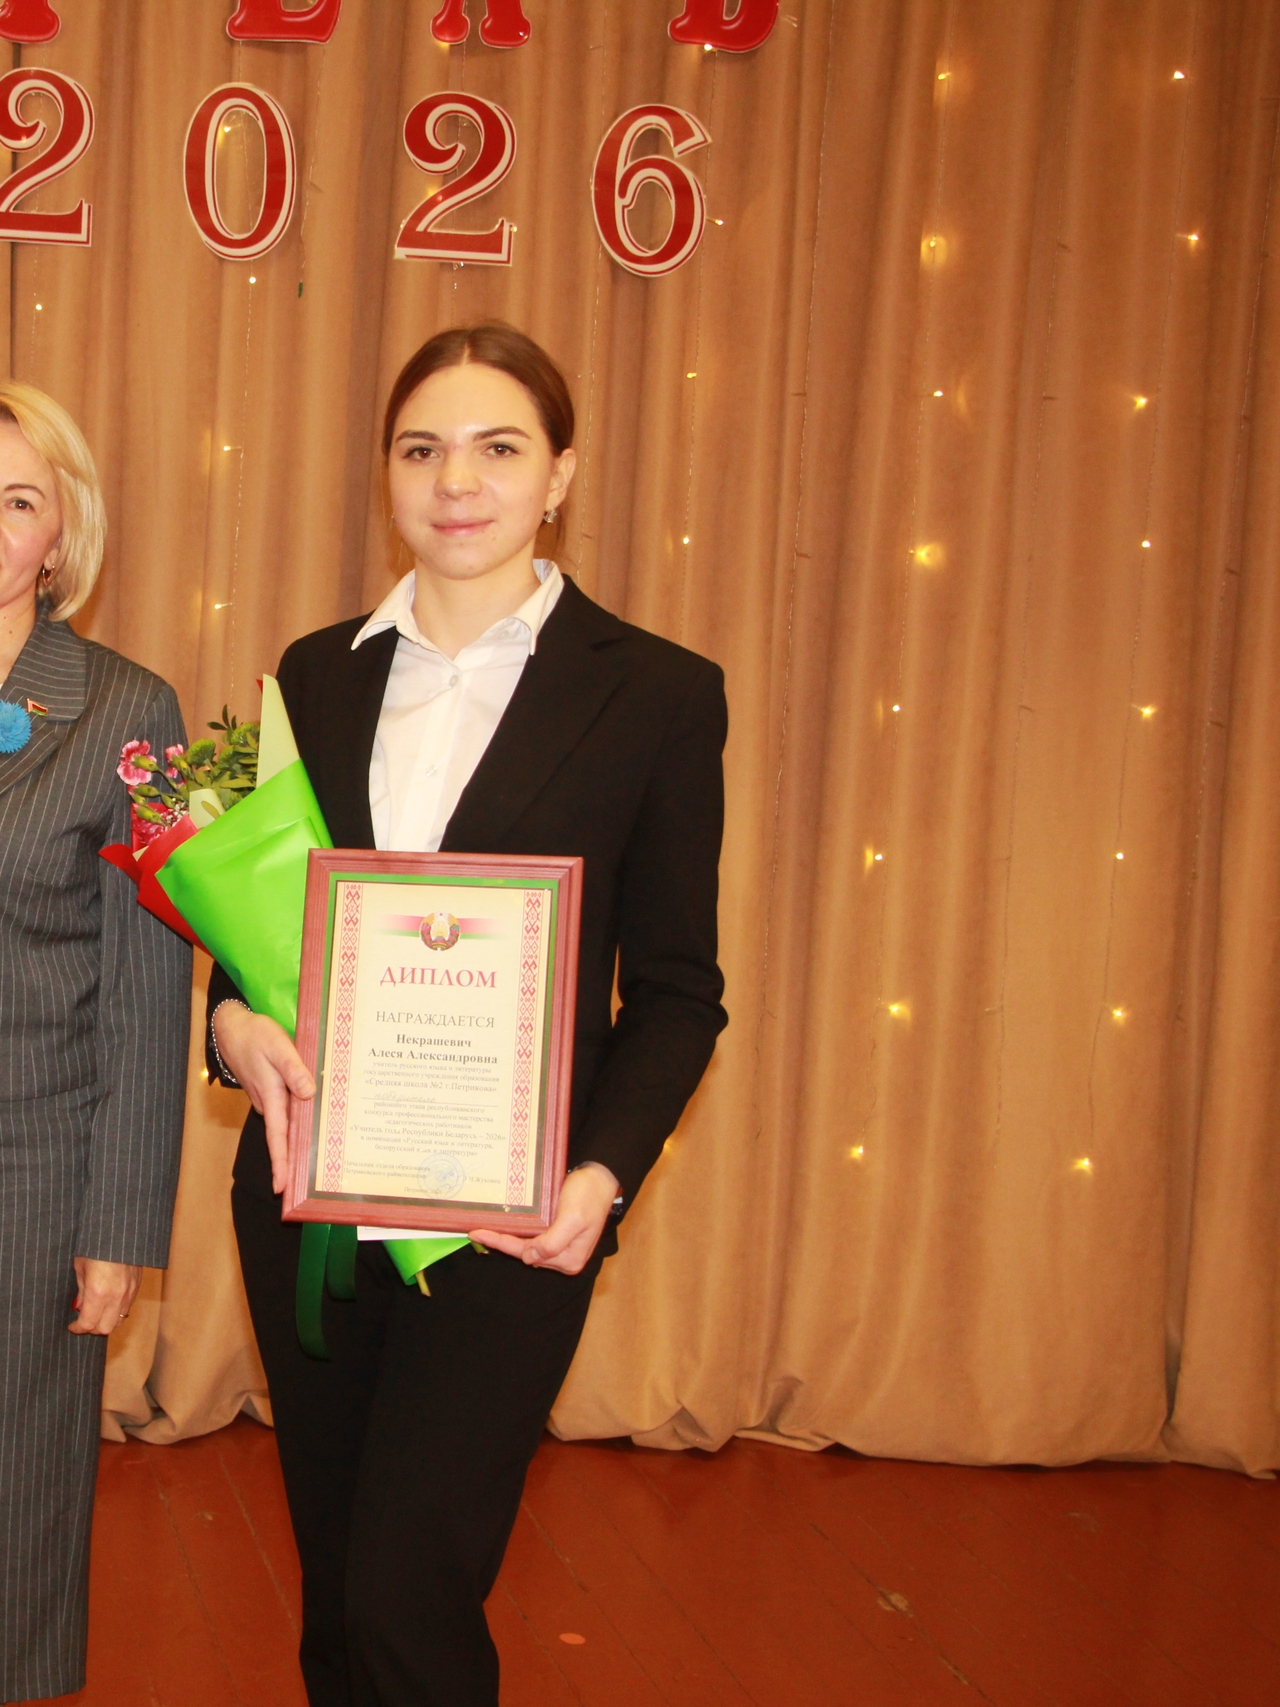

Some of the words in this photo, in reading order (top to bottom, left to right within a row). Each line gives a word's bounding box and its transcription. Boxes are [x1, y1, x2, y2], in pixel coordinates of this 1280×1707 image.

[380, 966, 497, 988] ДИПЛОМ
[376, 1011, 494, 1028] НАГРАЖДАЕТСЯ
[396, 1034, 471, 1047] Некрашевич
[368, 1048, 403, 1059] Алеся
[407, 1050, 497, 1065] Александровна
[460, 1074, 499, 1082] образования
[365, 1078, 401, 1086] «Средняя
[445, 1083, 497, 1092] г.Петрикова»
[395, 1111, 457, 1120] профессионального
[427, 1105, 484, 1113] республиканского
[350, 1125, 383, 1133] «Учитель
[402, 1128, 443, 1137] Республики
[445, 1131, 477, 1139] Беларусь
[375, 1144, 414, 1152] белорусский
[438, 1149, 477, 1157] литература»
